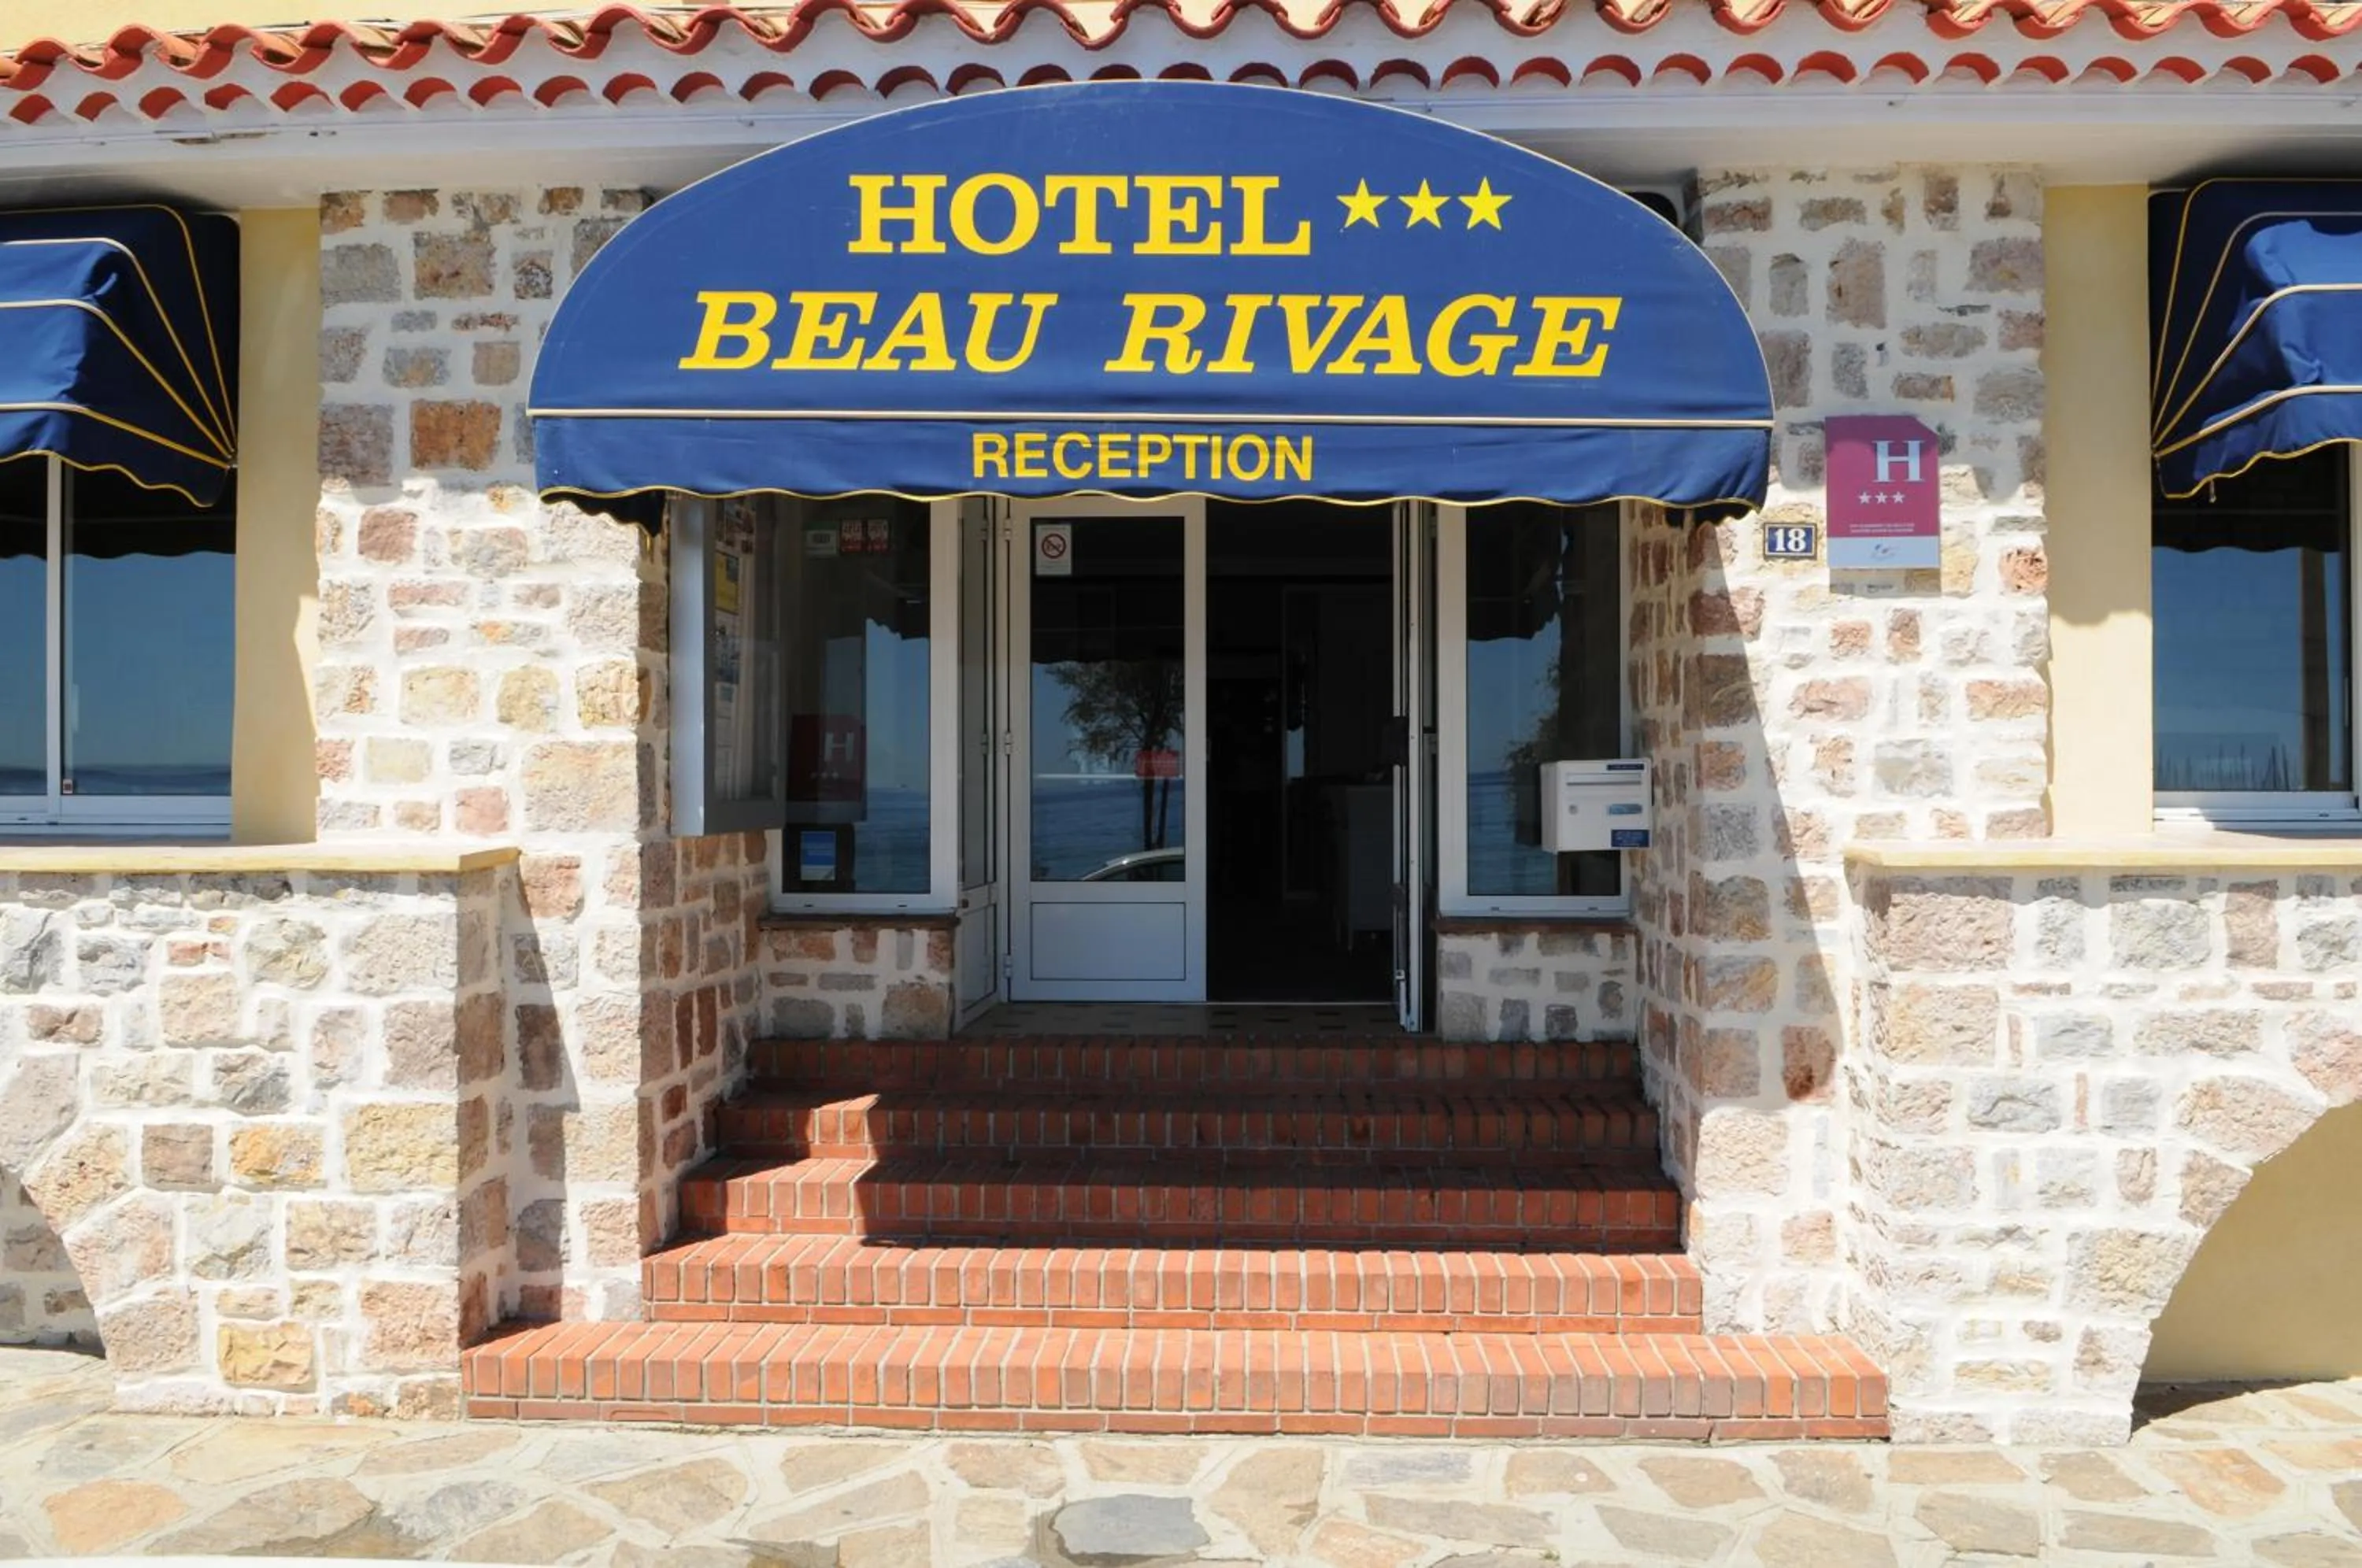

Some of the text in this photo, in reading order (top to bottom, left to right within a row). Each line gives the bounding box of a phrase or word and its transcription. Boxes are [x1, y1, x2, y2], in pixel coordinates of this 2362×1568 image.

[848, 172, 1311, 255] HOTEL
[678, 290, 1623, 377] BEAU RIVAGE
[972, 431, 1313, 482] RECEPTION
[1871, 440, 1924, 483] H
[1775, 528, 1807, 552] 18
[824, 731, 854, 762] H
